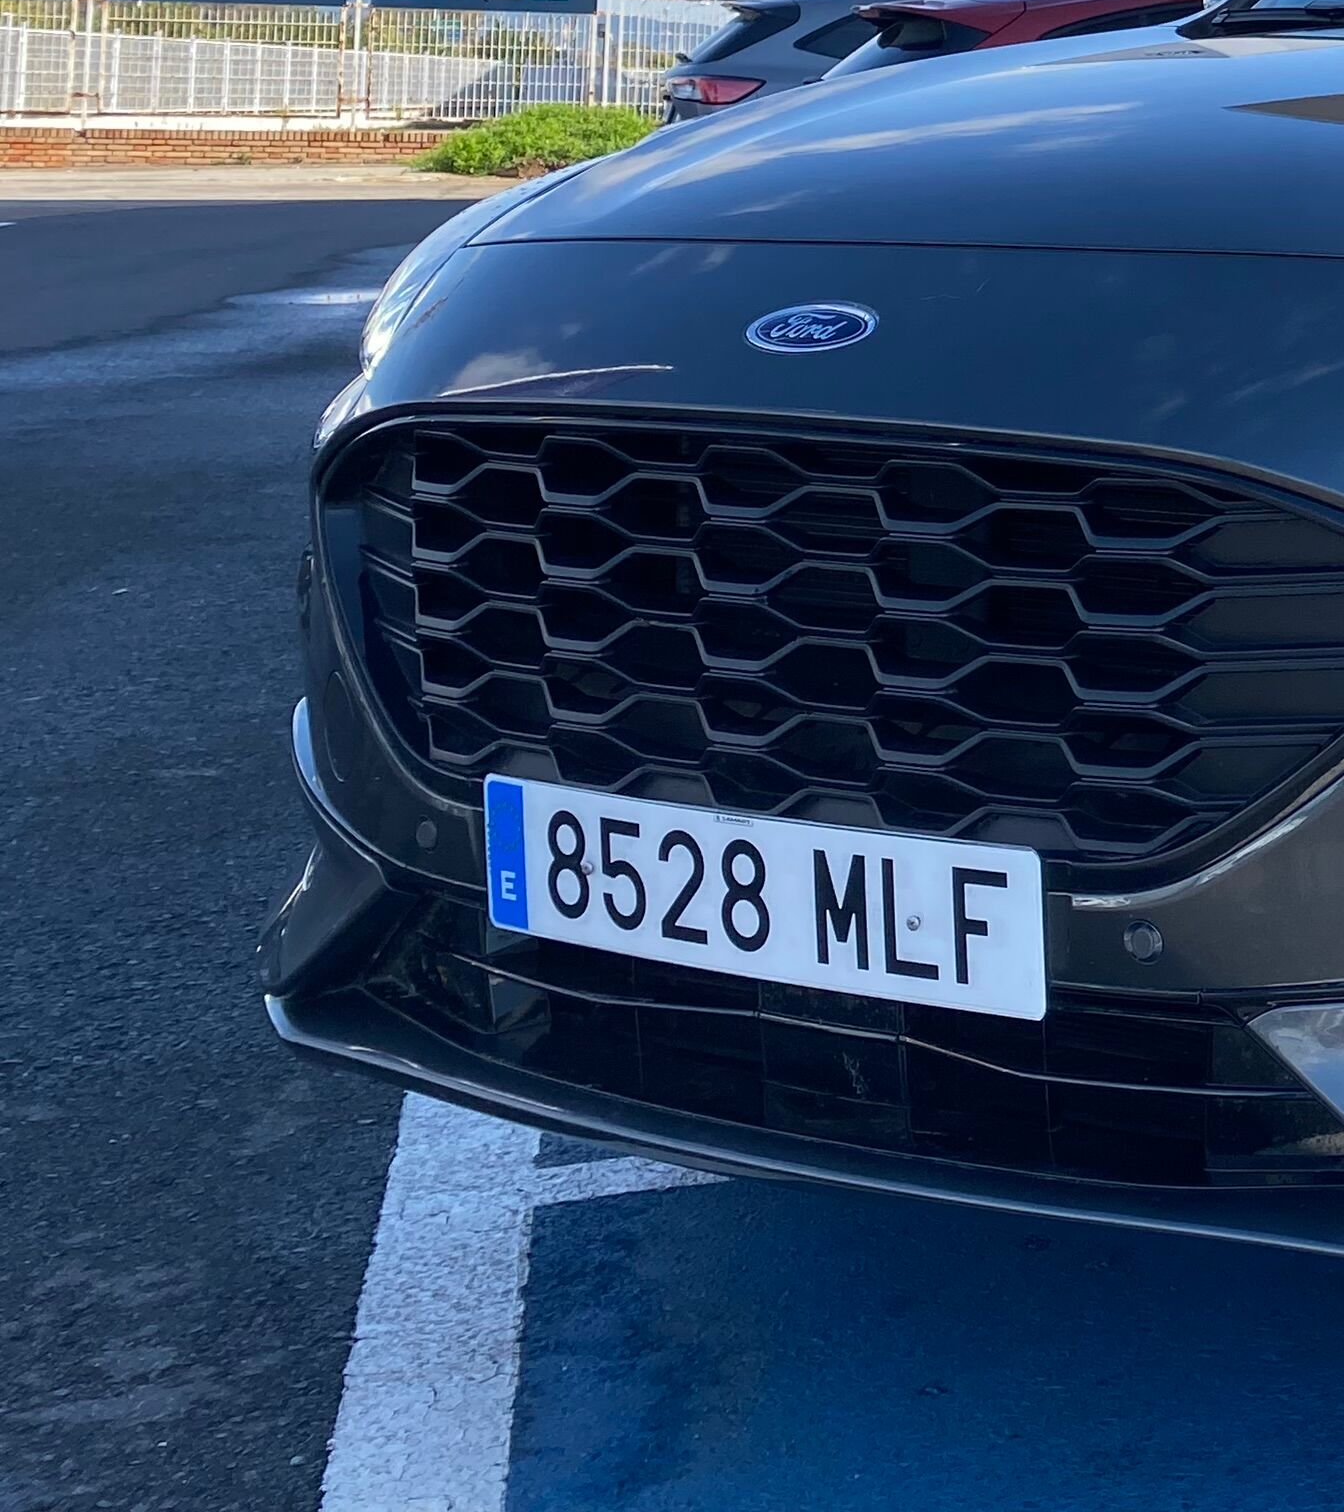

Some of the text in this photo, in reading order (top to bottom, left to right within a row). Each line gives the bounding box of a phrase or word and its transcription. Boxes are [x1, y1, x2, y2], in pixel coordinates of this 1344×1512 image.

[770, 313, 848, 340] Ford
[500, 810, 1008, 985] E 8528 MLF
